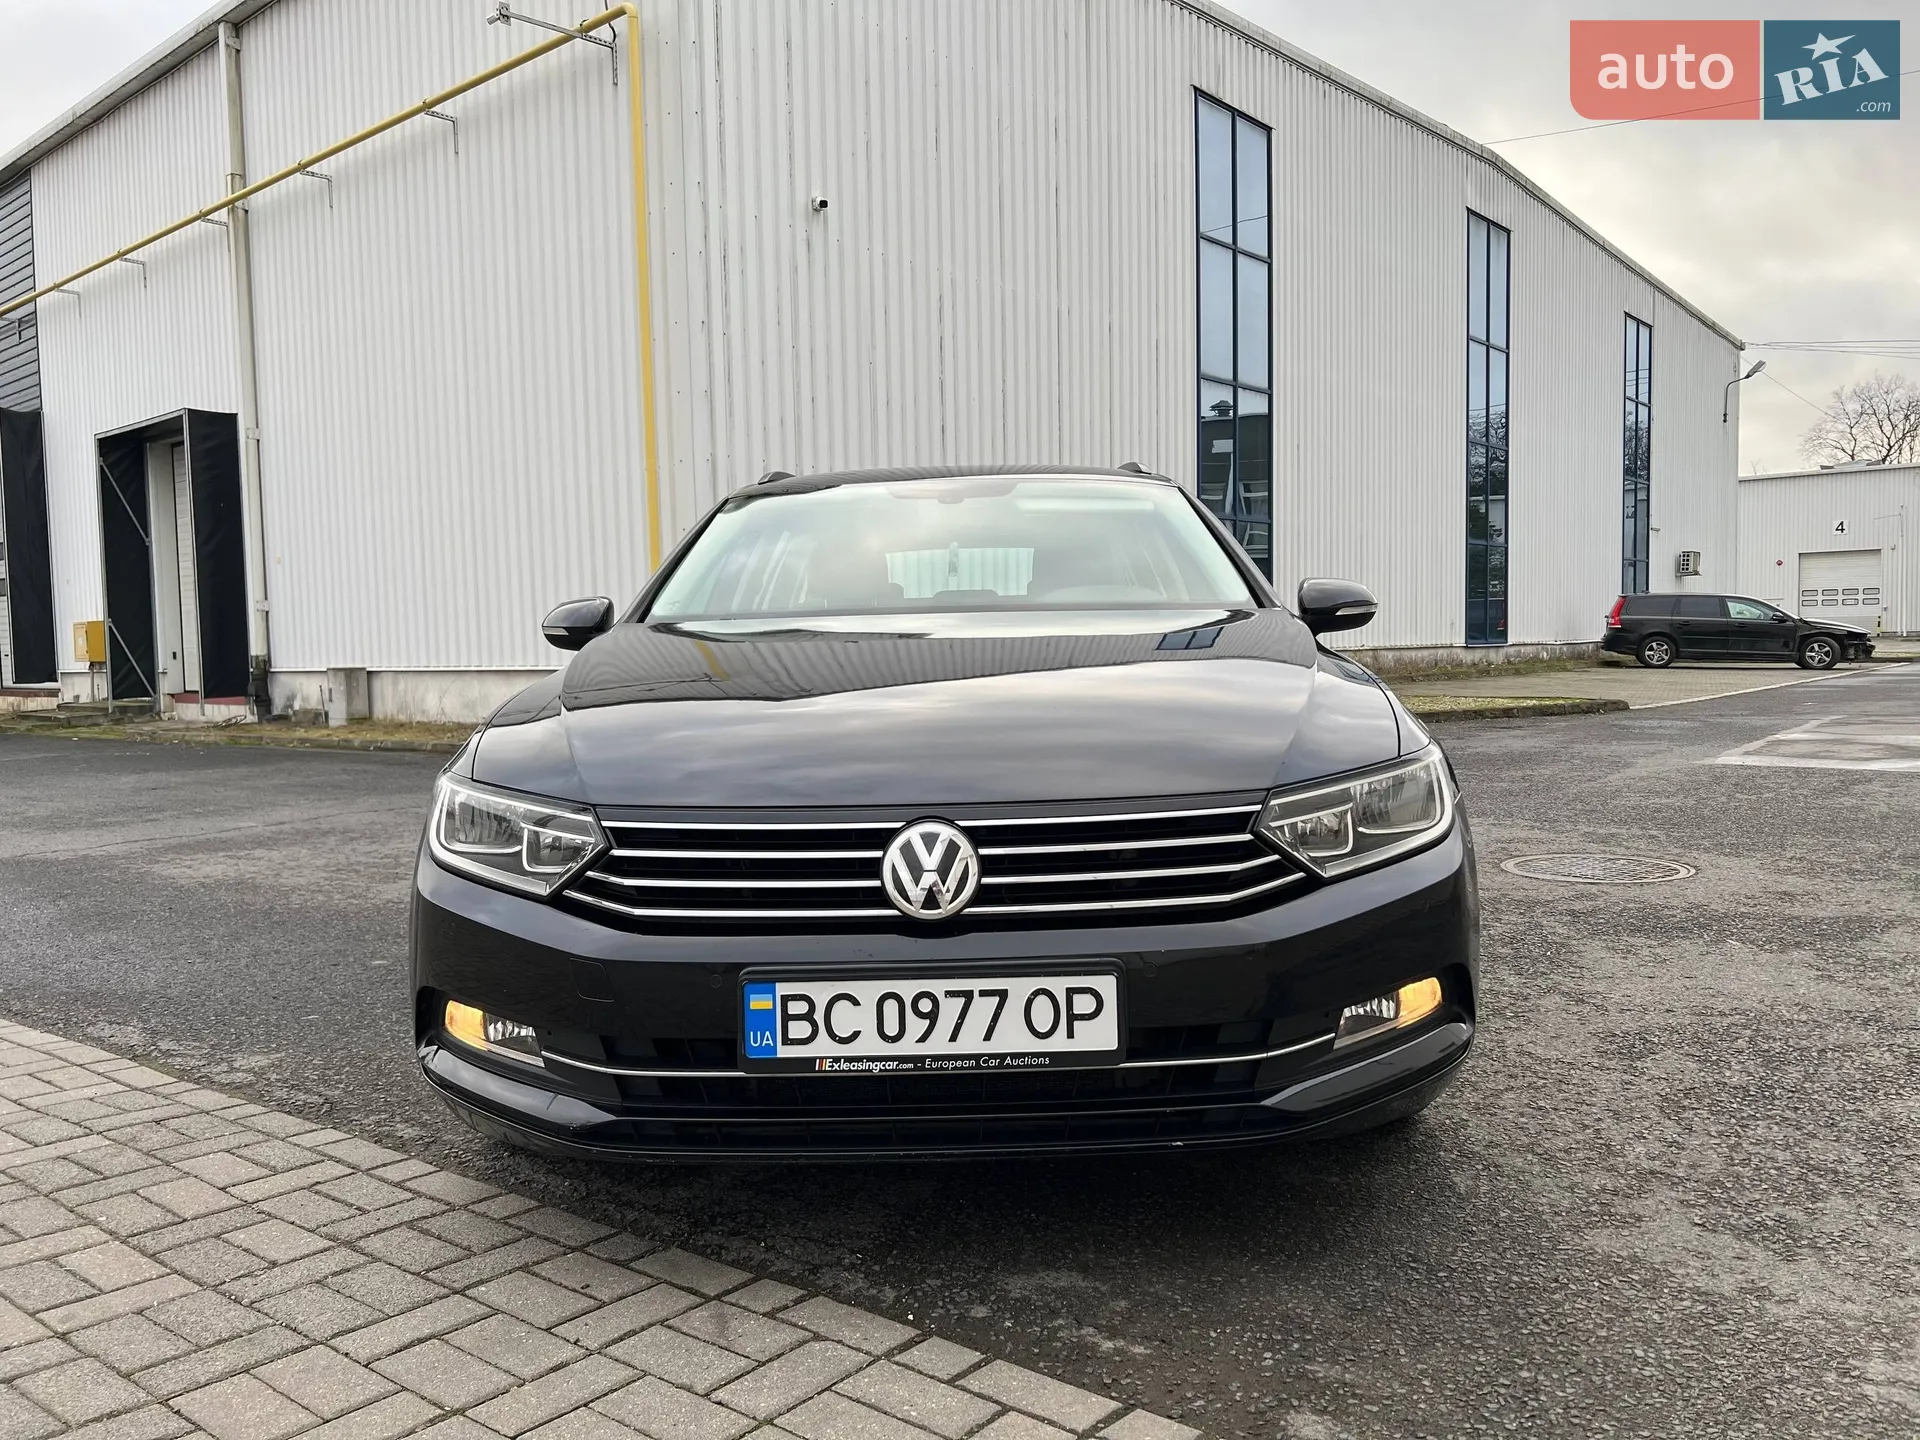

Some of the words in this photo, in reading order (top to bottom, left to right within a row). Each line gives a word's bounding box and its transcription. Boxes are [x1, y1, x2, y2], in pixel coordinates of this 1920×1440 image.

[1835, 520, 1846, 534] 4
[884, 822, 978, 919] VW
[779, 992, 862, 1046] BC
[876, 988, 1009, 1043] 0977
[1023, 987, 1105, 1040] OP
[749, 1030, 774, 1047] UA
[826, 1058, 914, 1073] Exleasingcar.com
[925, 1058, 976, 1070] European
[980, 1056, 1000, 1067] Car
[1003, 1055, 1050, 1066] Auctions
